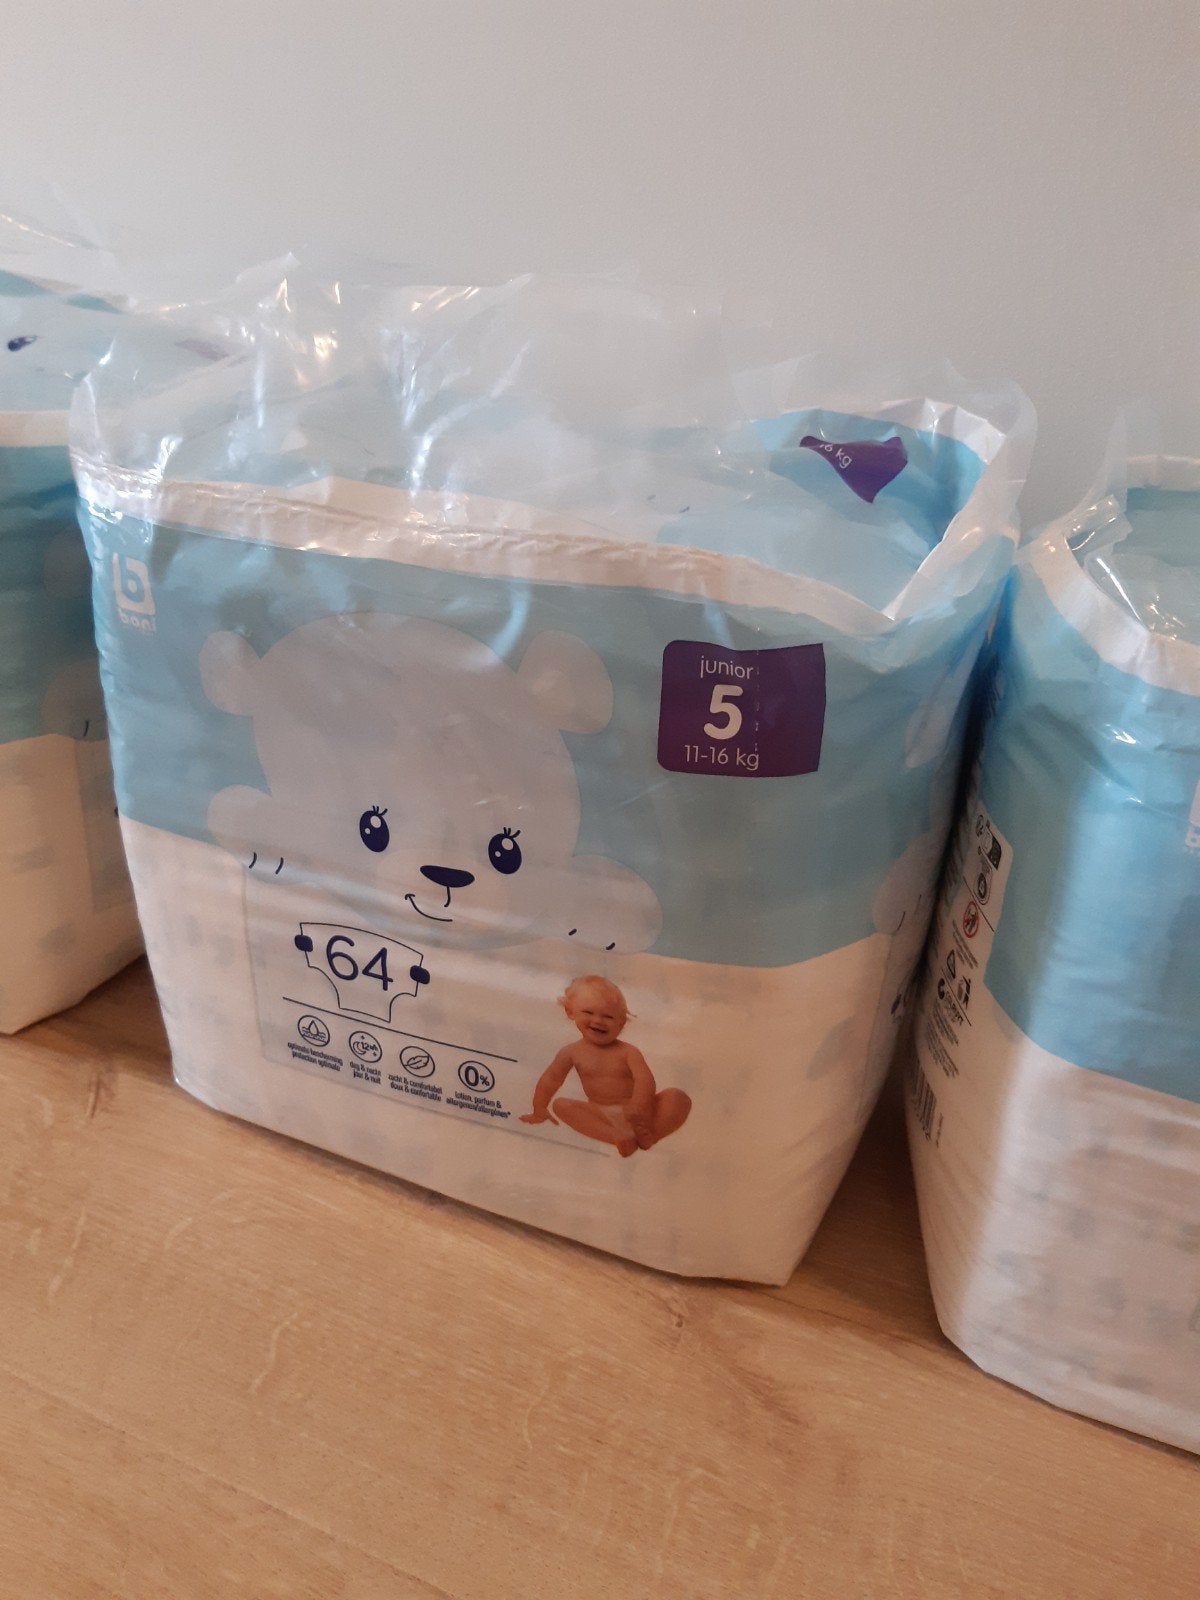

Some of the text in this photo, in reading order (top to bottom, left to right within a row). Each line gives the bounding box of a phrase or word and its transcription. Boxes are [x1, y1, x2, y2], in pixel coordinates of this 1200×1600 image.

[836, 447, 852, 469] kg
[118, 607, 156, 632] boni
[700, 655, 753, 679] junior
[703, 684, 744, 740] 5
[684, 745, 760, 771] 11-16 kg
[326, 935, 393, 991] 64
[465, 1065, 490, 1087] 0%
[496, 1100, 502, 1109] &
